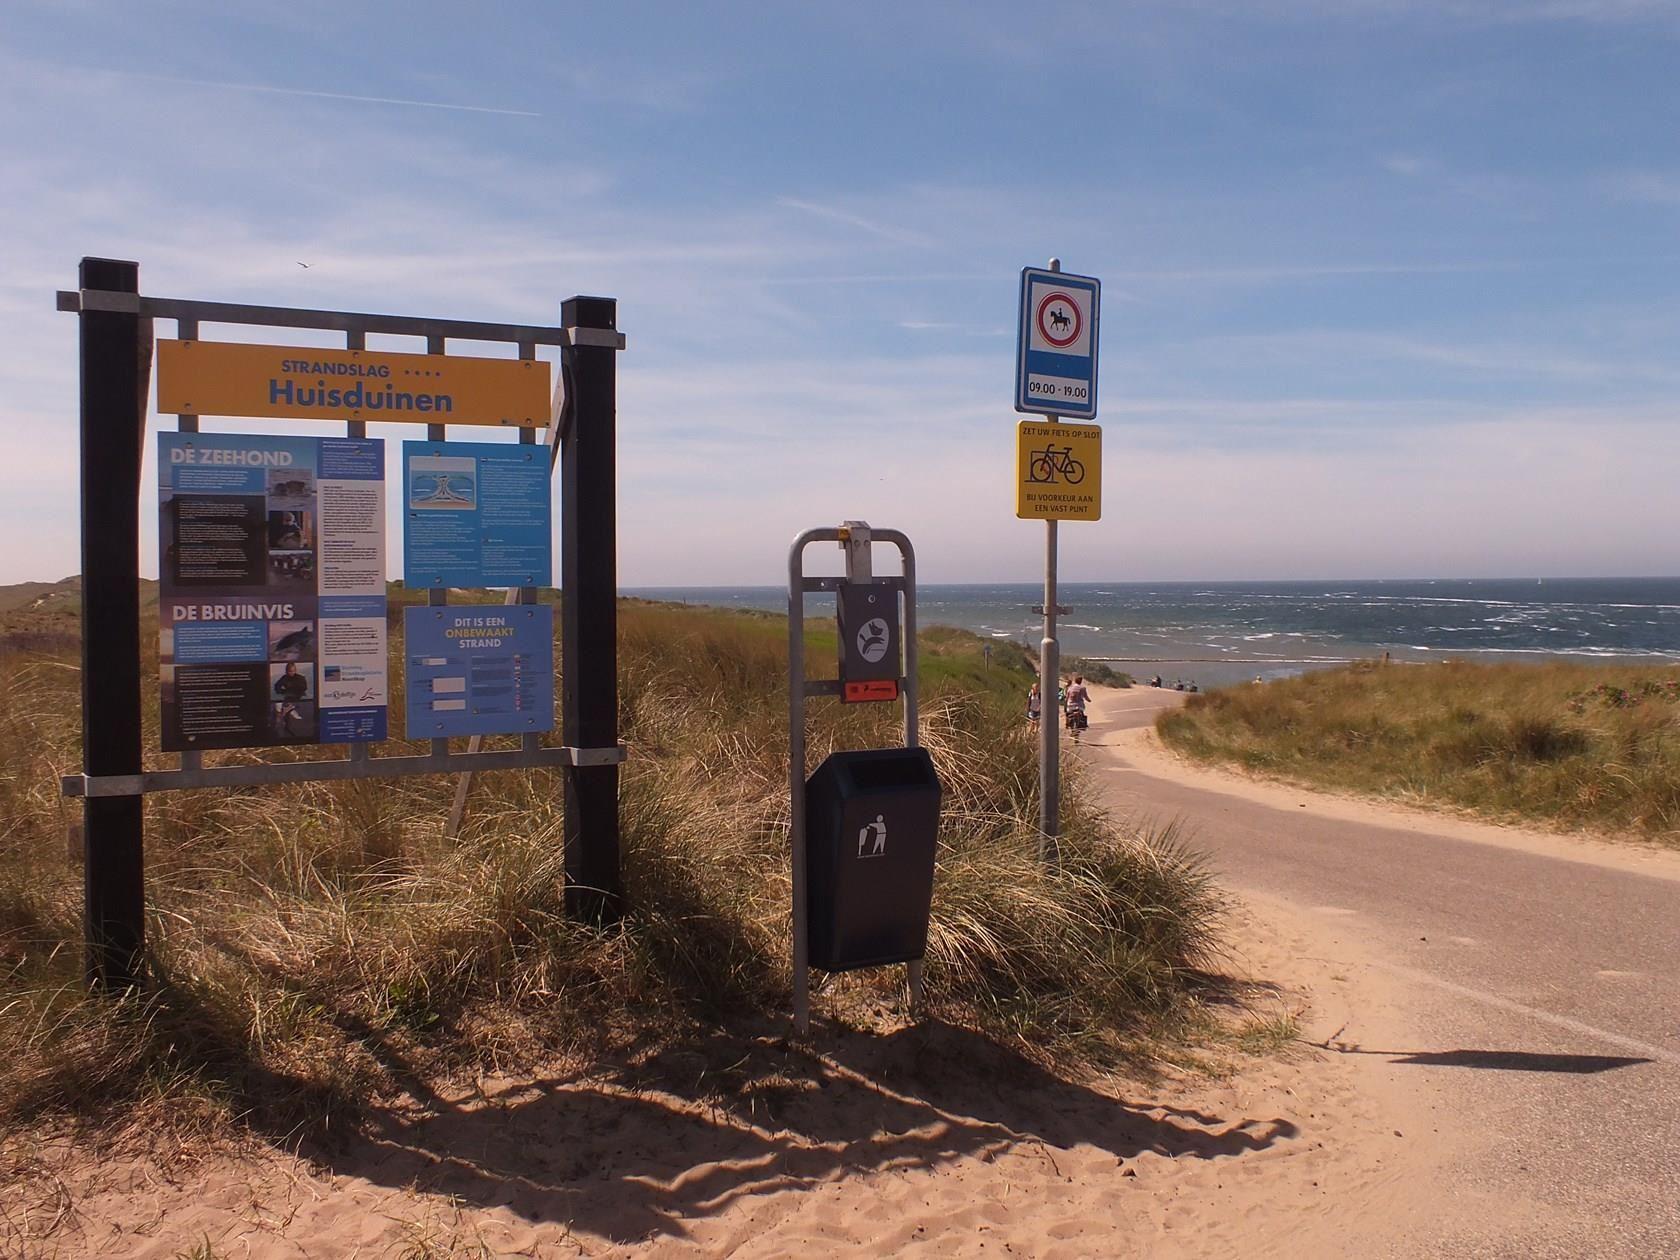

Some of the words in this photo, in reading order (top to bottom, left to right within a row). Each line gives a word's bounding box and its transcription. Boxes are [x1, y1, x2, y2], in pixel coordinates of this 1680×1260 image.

[281, 359, 391, 378] STRANDSLAG
[269, 378, 453, 413] Huisduinen
[1029, 381, 1056, 395] 09.00
[1063, 385, 1087, 398] 19.00
[1023, 427, 1036, 436] ZET
[1038, 428, 1050, 436] UW
[1052, 429, 1070, 438] FIETS
[1072, 430, 1082, 438] OP
[1084, 431, 1100, 439] SLOT
[170, 447, 196, 464] DE
[200, 449, 293, 466] ZEEHOND
[1038, 494, 1076, 502] VOORKEUR
[1034, 504, 1048, 512] EEN
[1050, 504, 1068, 512] VAST
[1070, 505, 1088, 513] PUNT
[172, 605, 198, 621] DE
[201, 604, 295, 621] BRUINVIS
[455, 618, 471, 627] DIT
[474, 618, 484, 626] IS
[486, 617, 505, 626] EEN
[445, 627, 514, 639] ONBEWAAKT
[459, 638, 502, 648] STRAND
